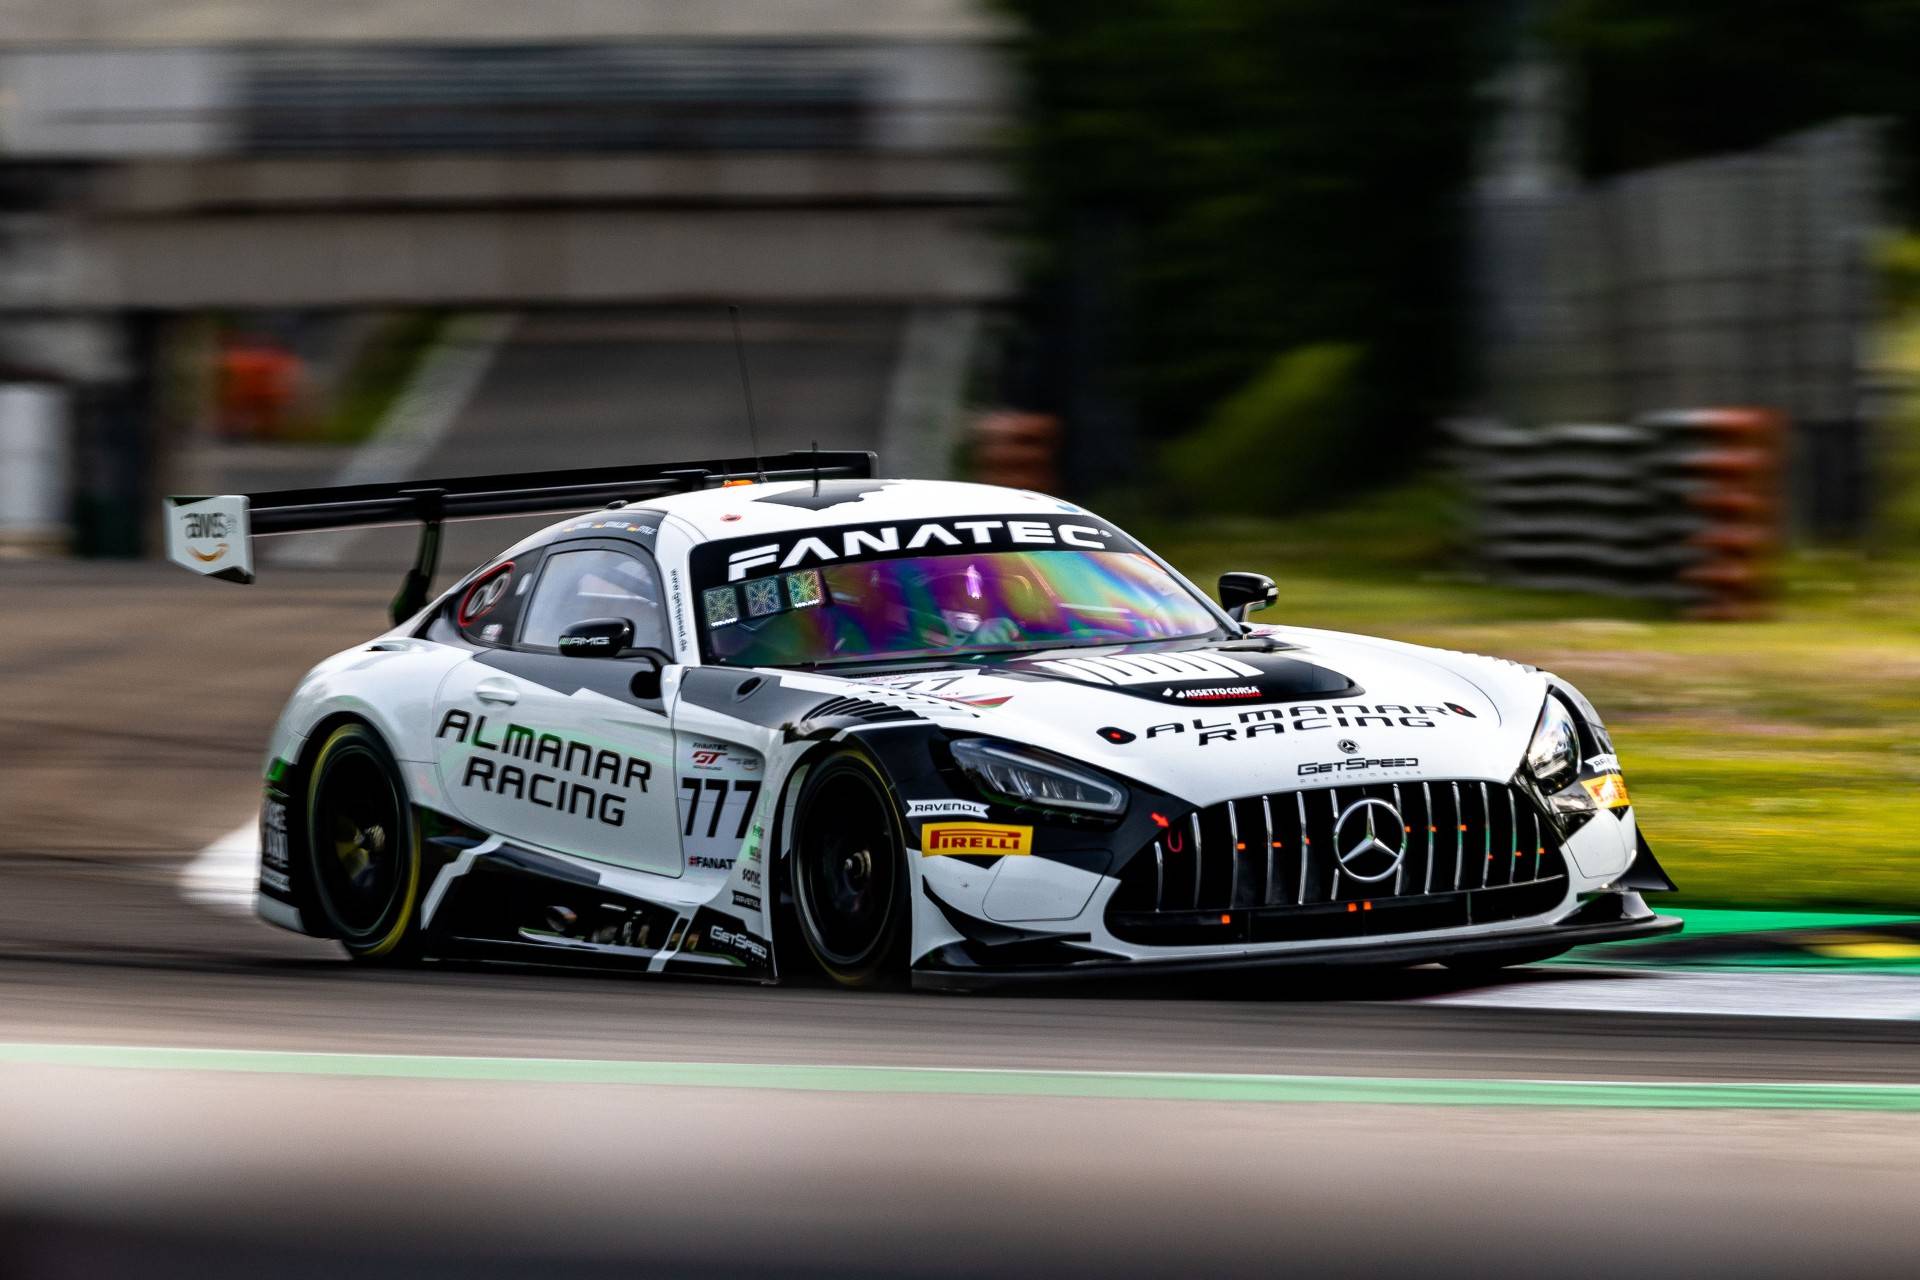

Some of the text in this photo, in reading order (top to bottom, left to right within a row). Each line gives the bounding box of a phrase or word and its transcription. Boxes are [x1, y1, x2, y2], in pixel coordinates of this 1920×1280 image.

[728, 521, 1106, 582] FANATEC
[568, 636, 610, 646] AMG
[1185, 687, 1228, 697] ASSETTO
[1227, 685, 1260, 695] CORSA
[1146, 704, 1450, 739] ALMANAR
[1198, 716, 1436, 747] RACING
[435, 708, 653, 793] ALMANAR
[461, 755, 627, 827] RACING
[681, 776, 762, 839] 777
[914, 802, 981, 813] RAVENOL
[929, 828, 1022, 850] PIRELLI
